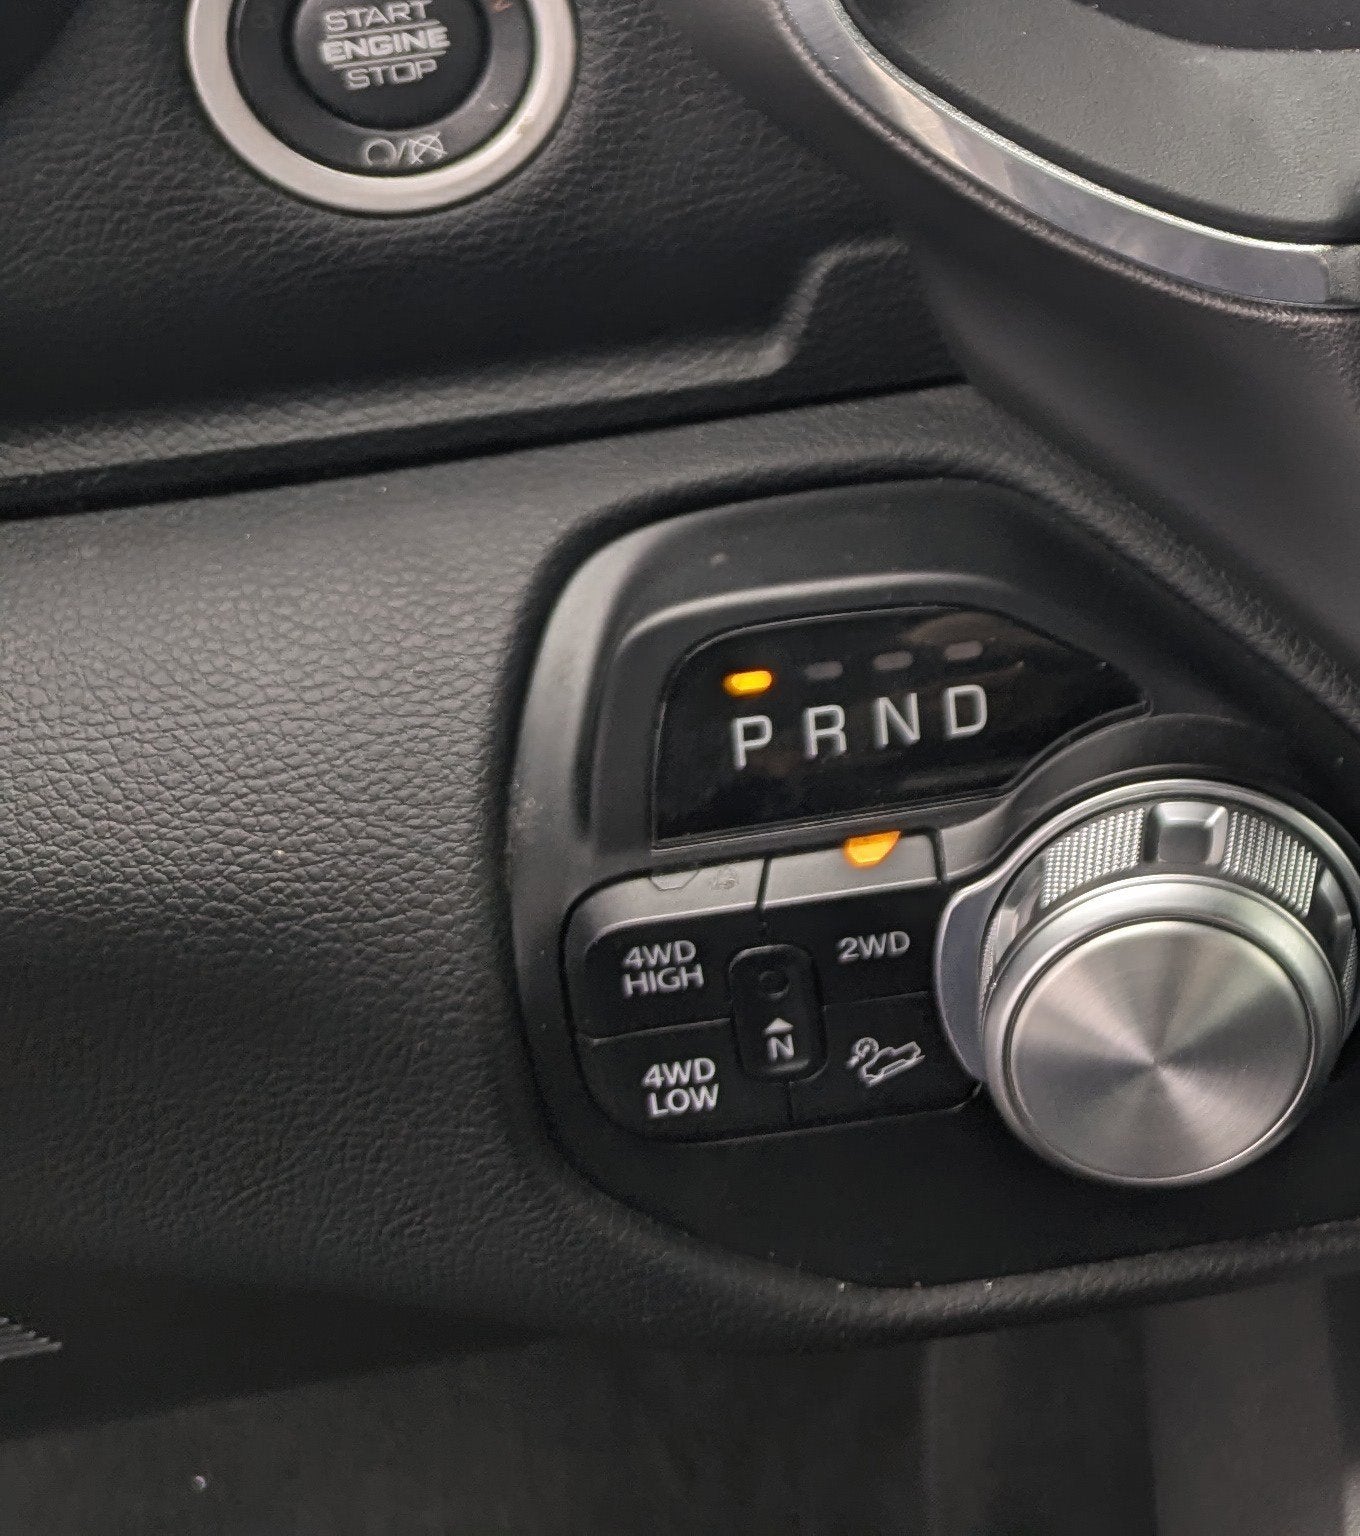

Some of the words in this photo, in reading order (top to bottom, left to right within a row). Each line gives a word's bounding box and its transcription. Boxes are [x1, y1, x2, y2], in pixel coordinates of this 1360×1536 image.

[319, 26, 451, 64] ENGINE
[344, 58, 438, 92] STOP
[731, 714, 773, 770] P
[803, 703, 848, 759] R
[873, 692, 922, 749] N
[943, 682, 989, 739] D
[622, 939, 698, 969] 4WD
[838, 929, 911, 963] 2WD
[621, 964, 705, 998] HIGH
[766, 1033, 796, 1061] N
[642, 1056, 717, 1088] 4WD
[648, 1083, 721, 1119] LOW
